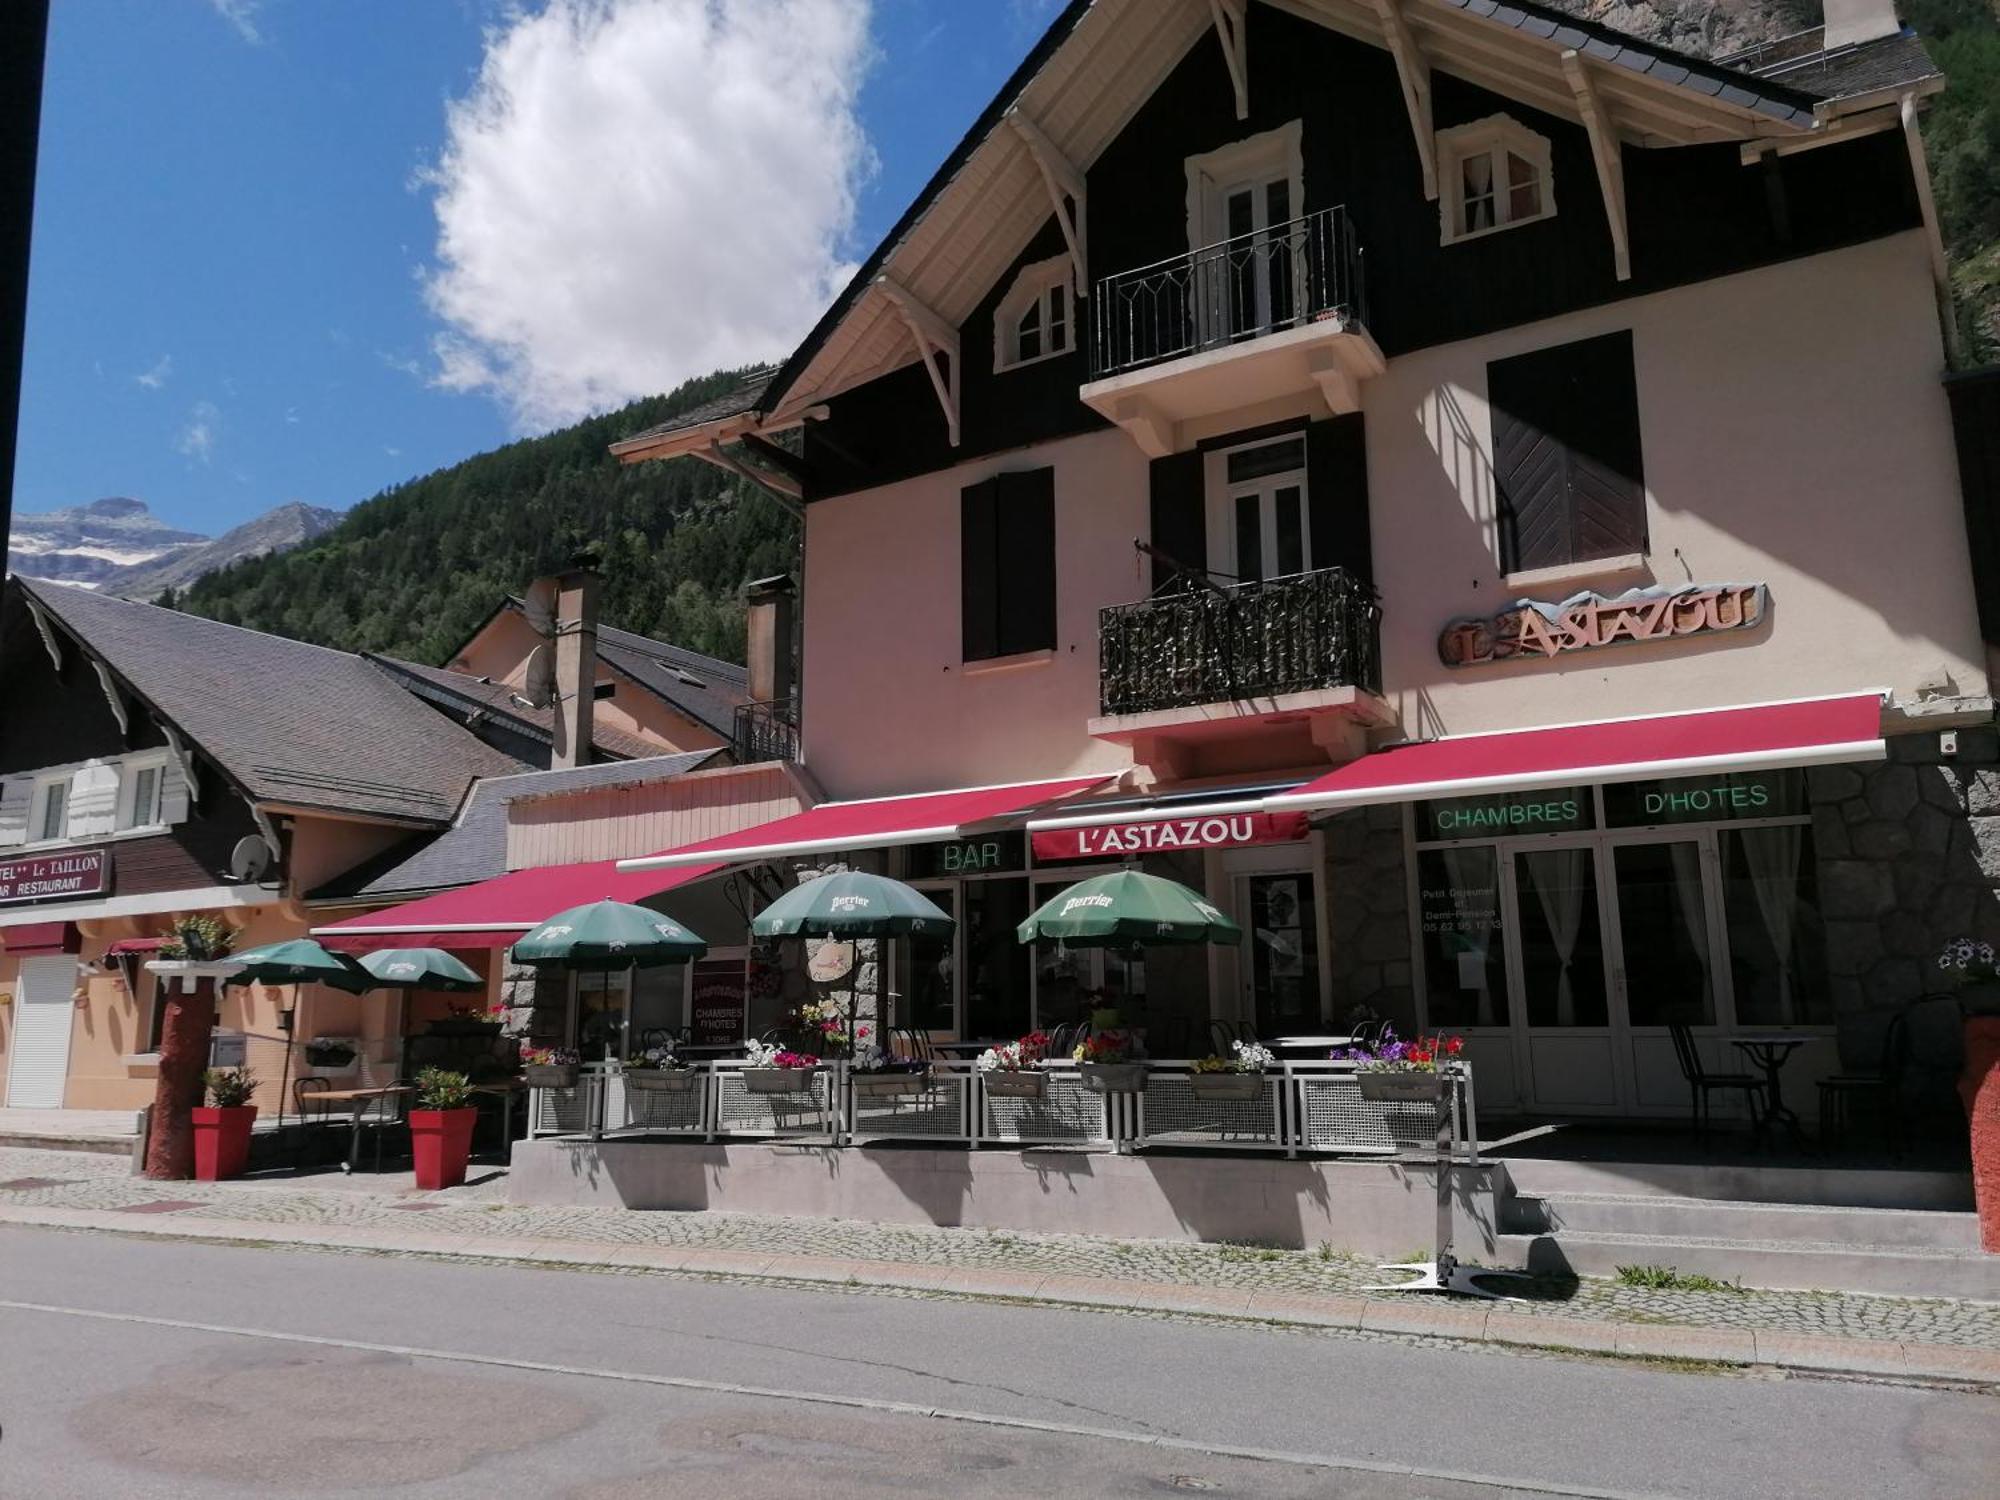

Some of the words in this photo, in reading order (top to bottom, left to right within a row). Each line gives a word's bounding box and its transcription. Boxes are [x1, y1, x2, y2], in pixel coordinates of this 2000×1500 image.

[1437, 800, 1578, 830] CHAMBRES
[1645, 785, 1768, 814] D'HOTES
[1078, 816, 1253, 854] L'ASTAZOU
[33, 863, 45, 877] Le
[50, 856, 100, 875] TAILLON
[944, 843, 1000, 872] BAR
[17, 877, 82, 896] RESTAURANT
[695, 1008, 743, 1019] CHAMBRES
